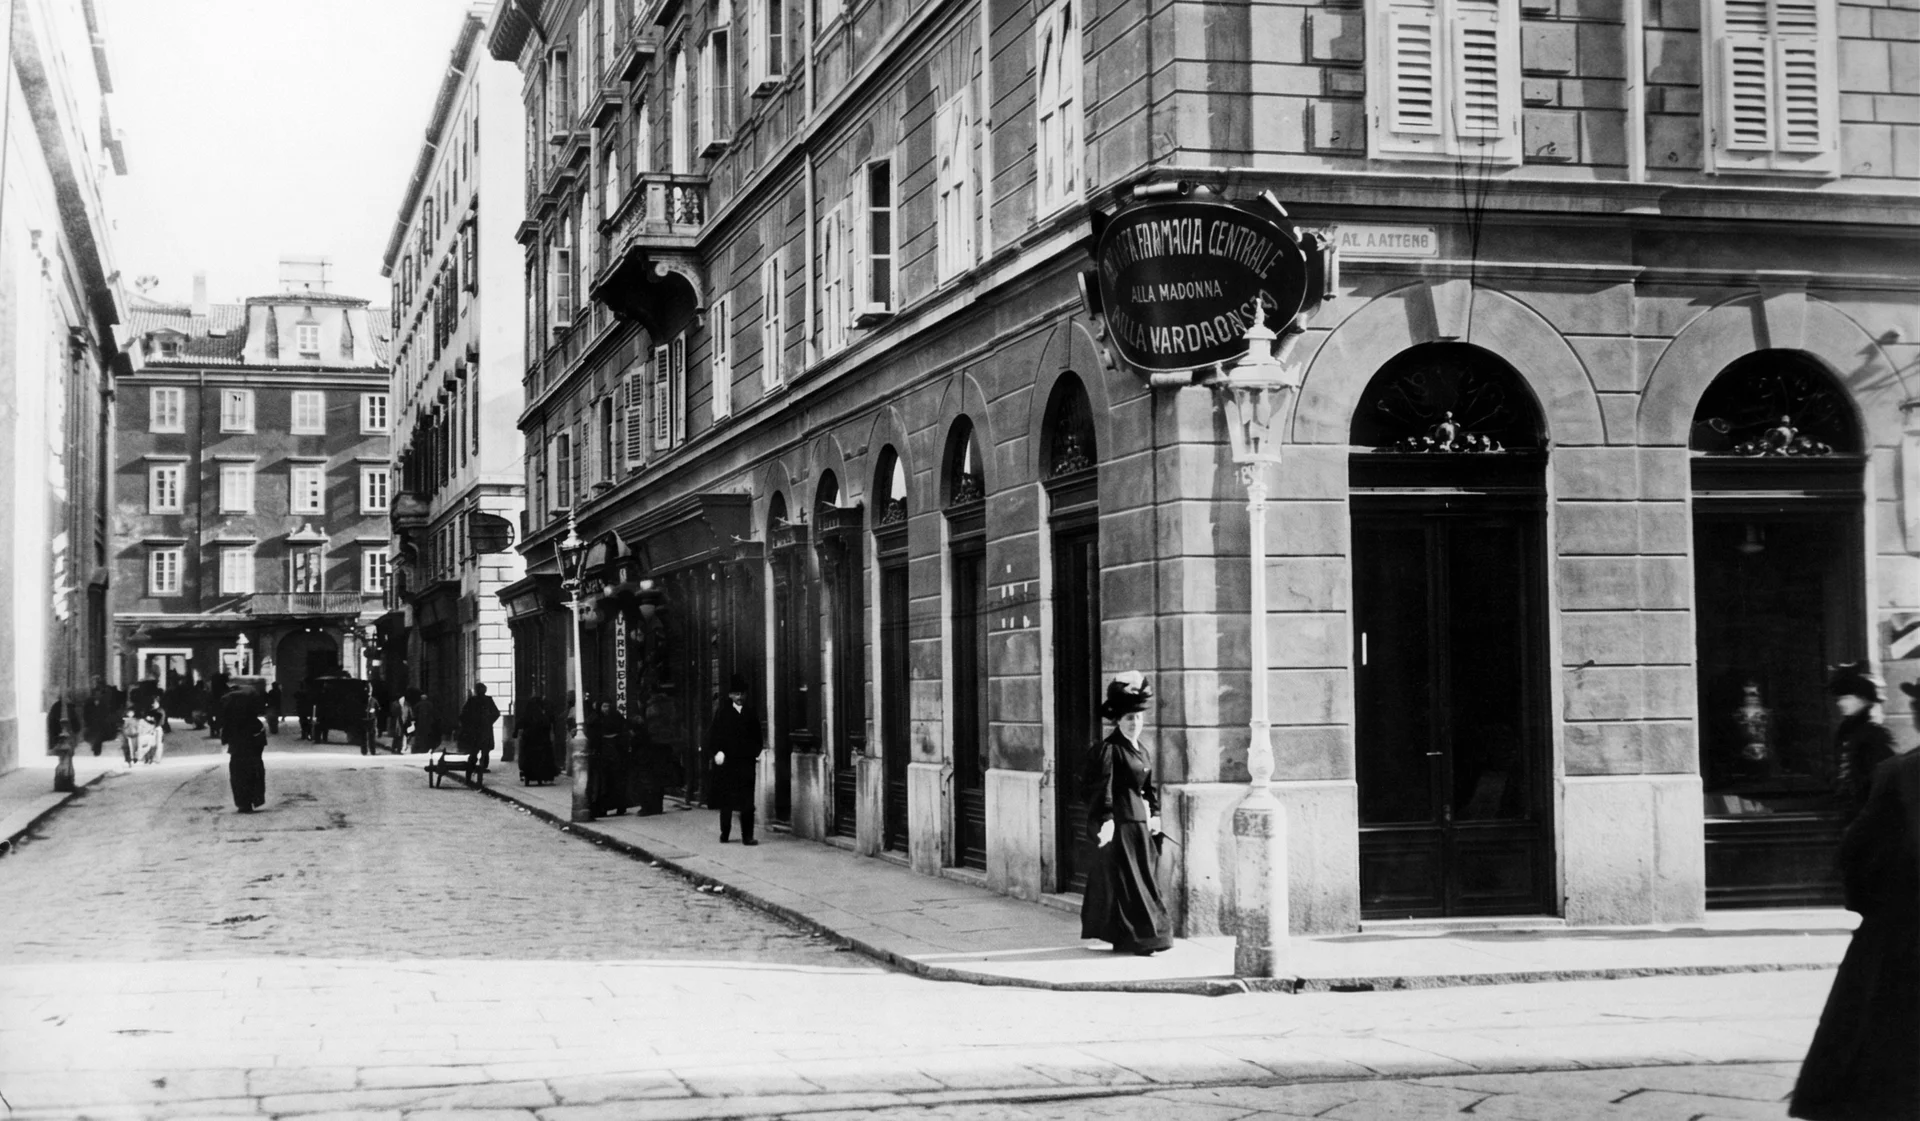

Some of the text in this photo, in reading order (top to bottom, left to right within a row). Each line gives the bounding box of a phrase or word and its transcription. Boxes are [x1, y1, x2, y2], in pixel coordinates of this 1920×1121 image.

[1135, 217, 1203, 262] FARMACIA
[1208, 219, 1284, 280] CENTRALE
[1131, 279, 1223, 303] ALLA MADONNA
